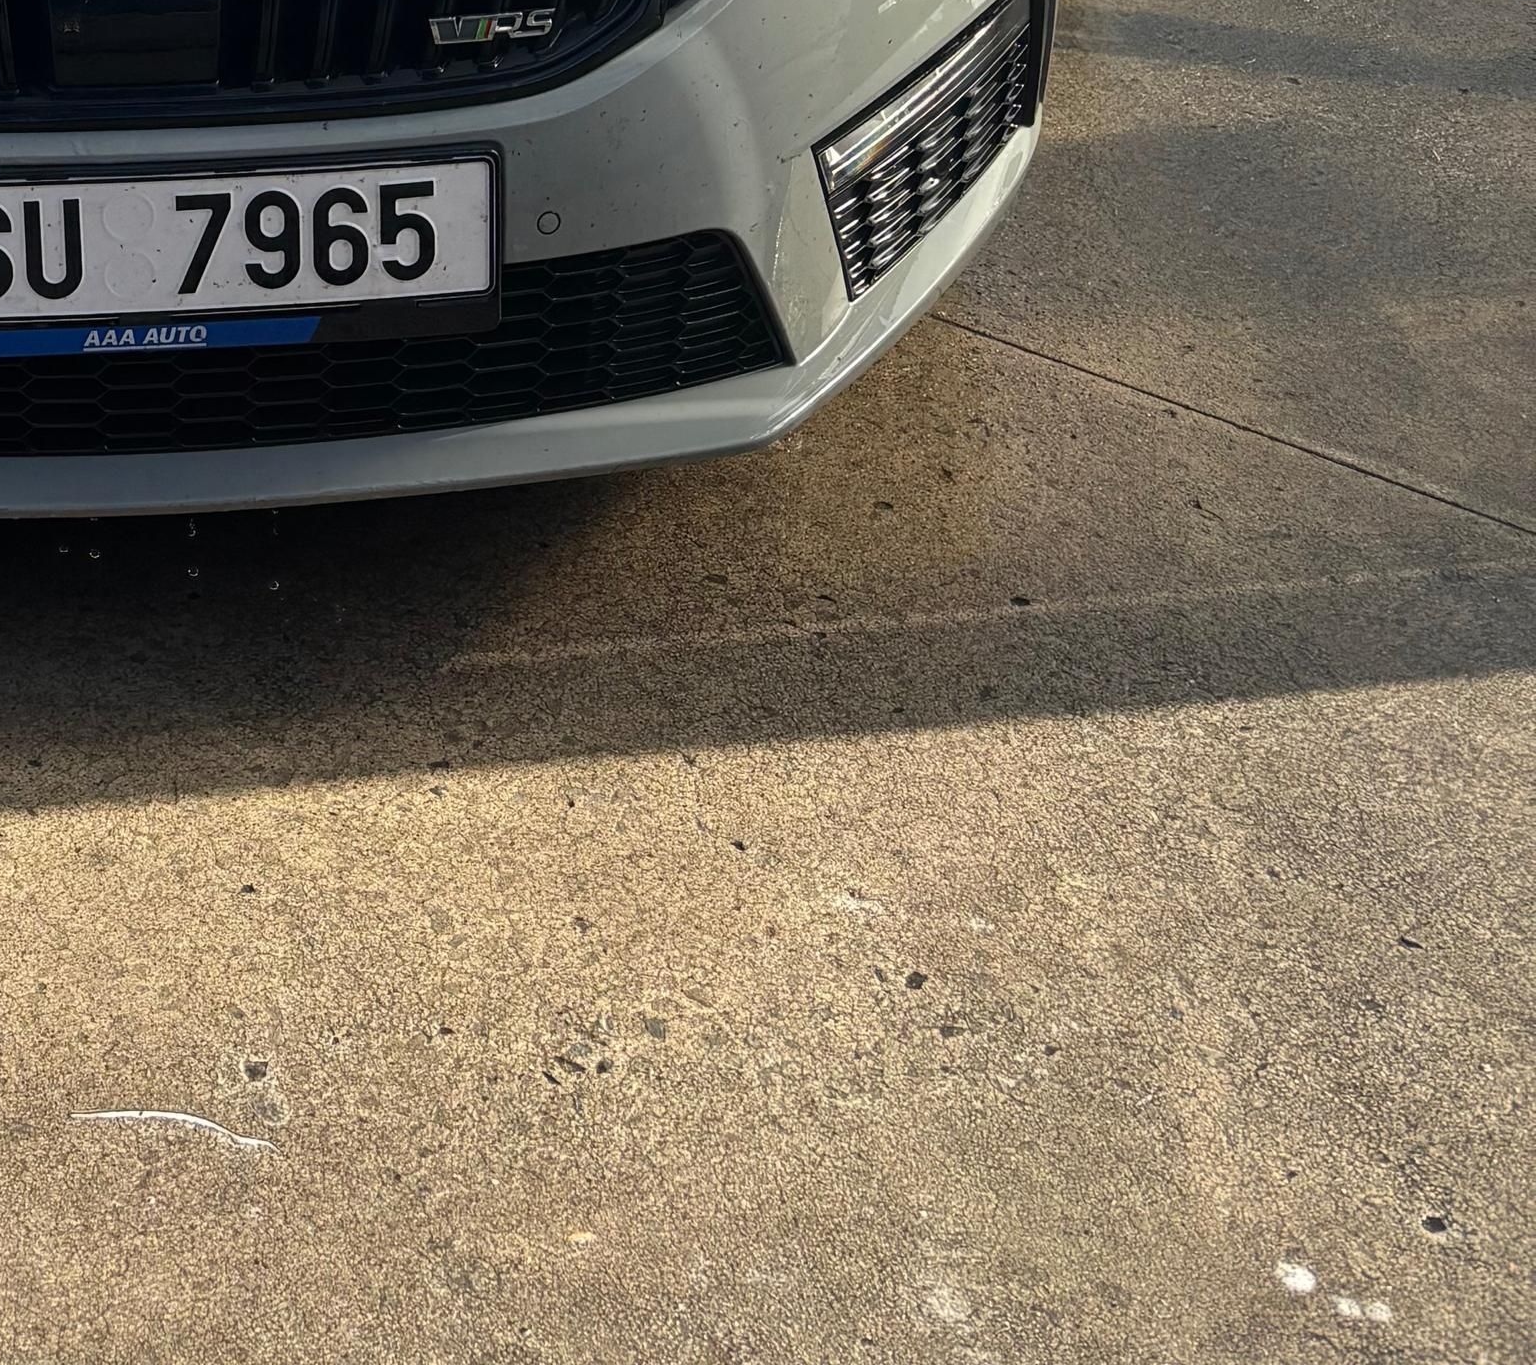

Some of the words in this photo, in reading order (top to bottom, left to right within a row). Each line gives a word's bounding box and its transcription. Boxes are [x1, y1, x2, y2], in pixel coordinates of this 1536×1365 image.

[173, 180, 438, 296] 7965
[83, 329, 136, 347] AAA
[142, 325, 208, 344] AUTO
